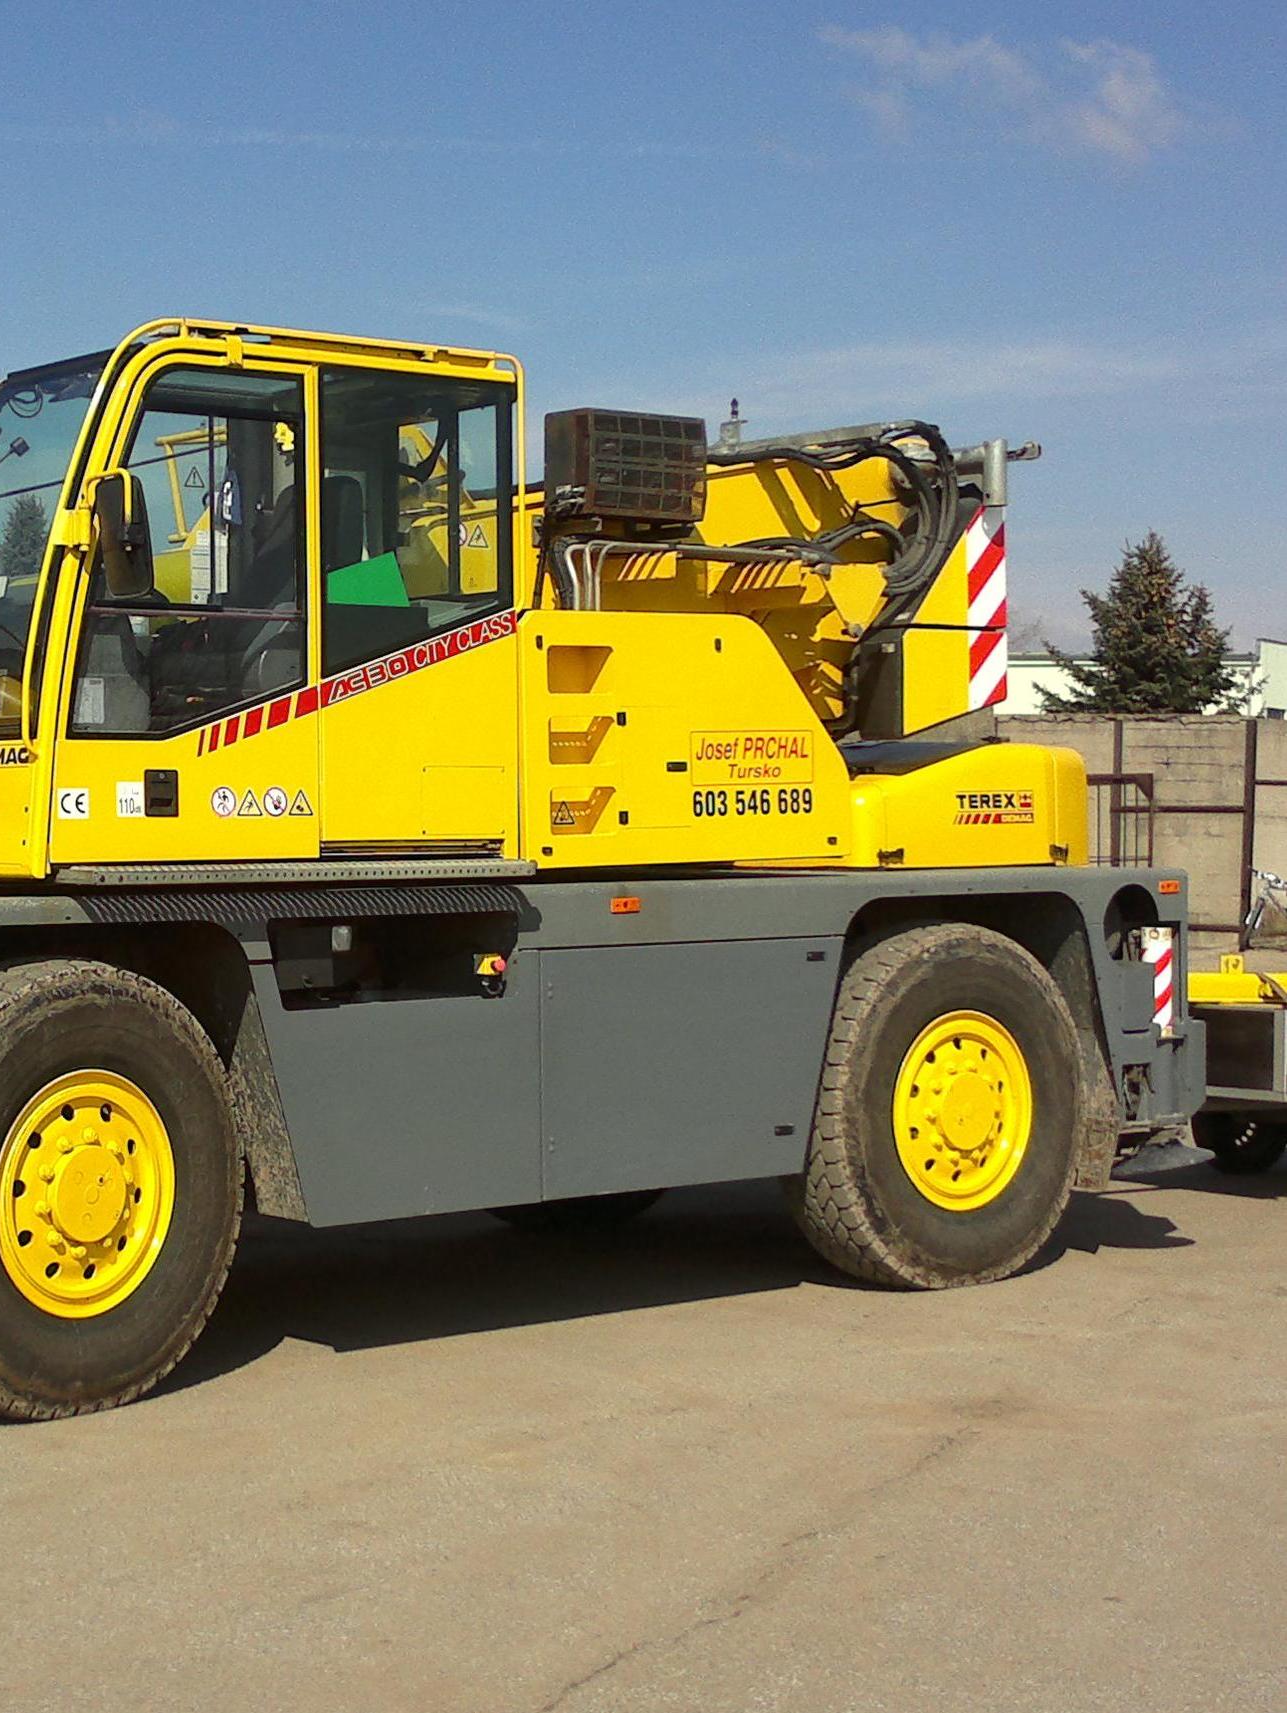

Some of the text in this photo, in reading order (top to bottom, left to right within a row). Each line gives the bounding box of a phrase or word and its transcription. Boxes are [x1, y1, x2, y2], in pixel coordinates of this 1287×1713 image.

[413, 635, 451, 668] CITY
[457, 613, 512, 650] CLASS
[696, 736, 808, 760] Josef PRCHAL
[728, 763, 781, 778] Tursko
[60, 793, 85, 814] CE
[693, 788, 812, 817] 603 546 689
[956, 794, 1015, 809] TEREX
